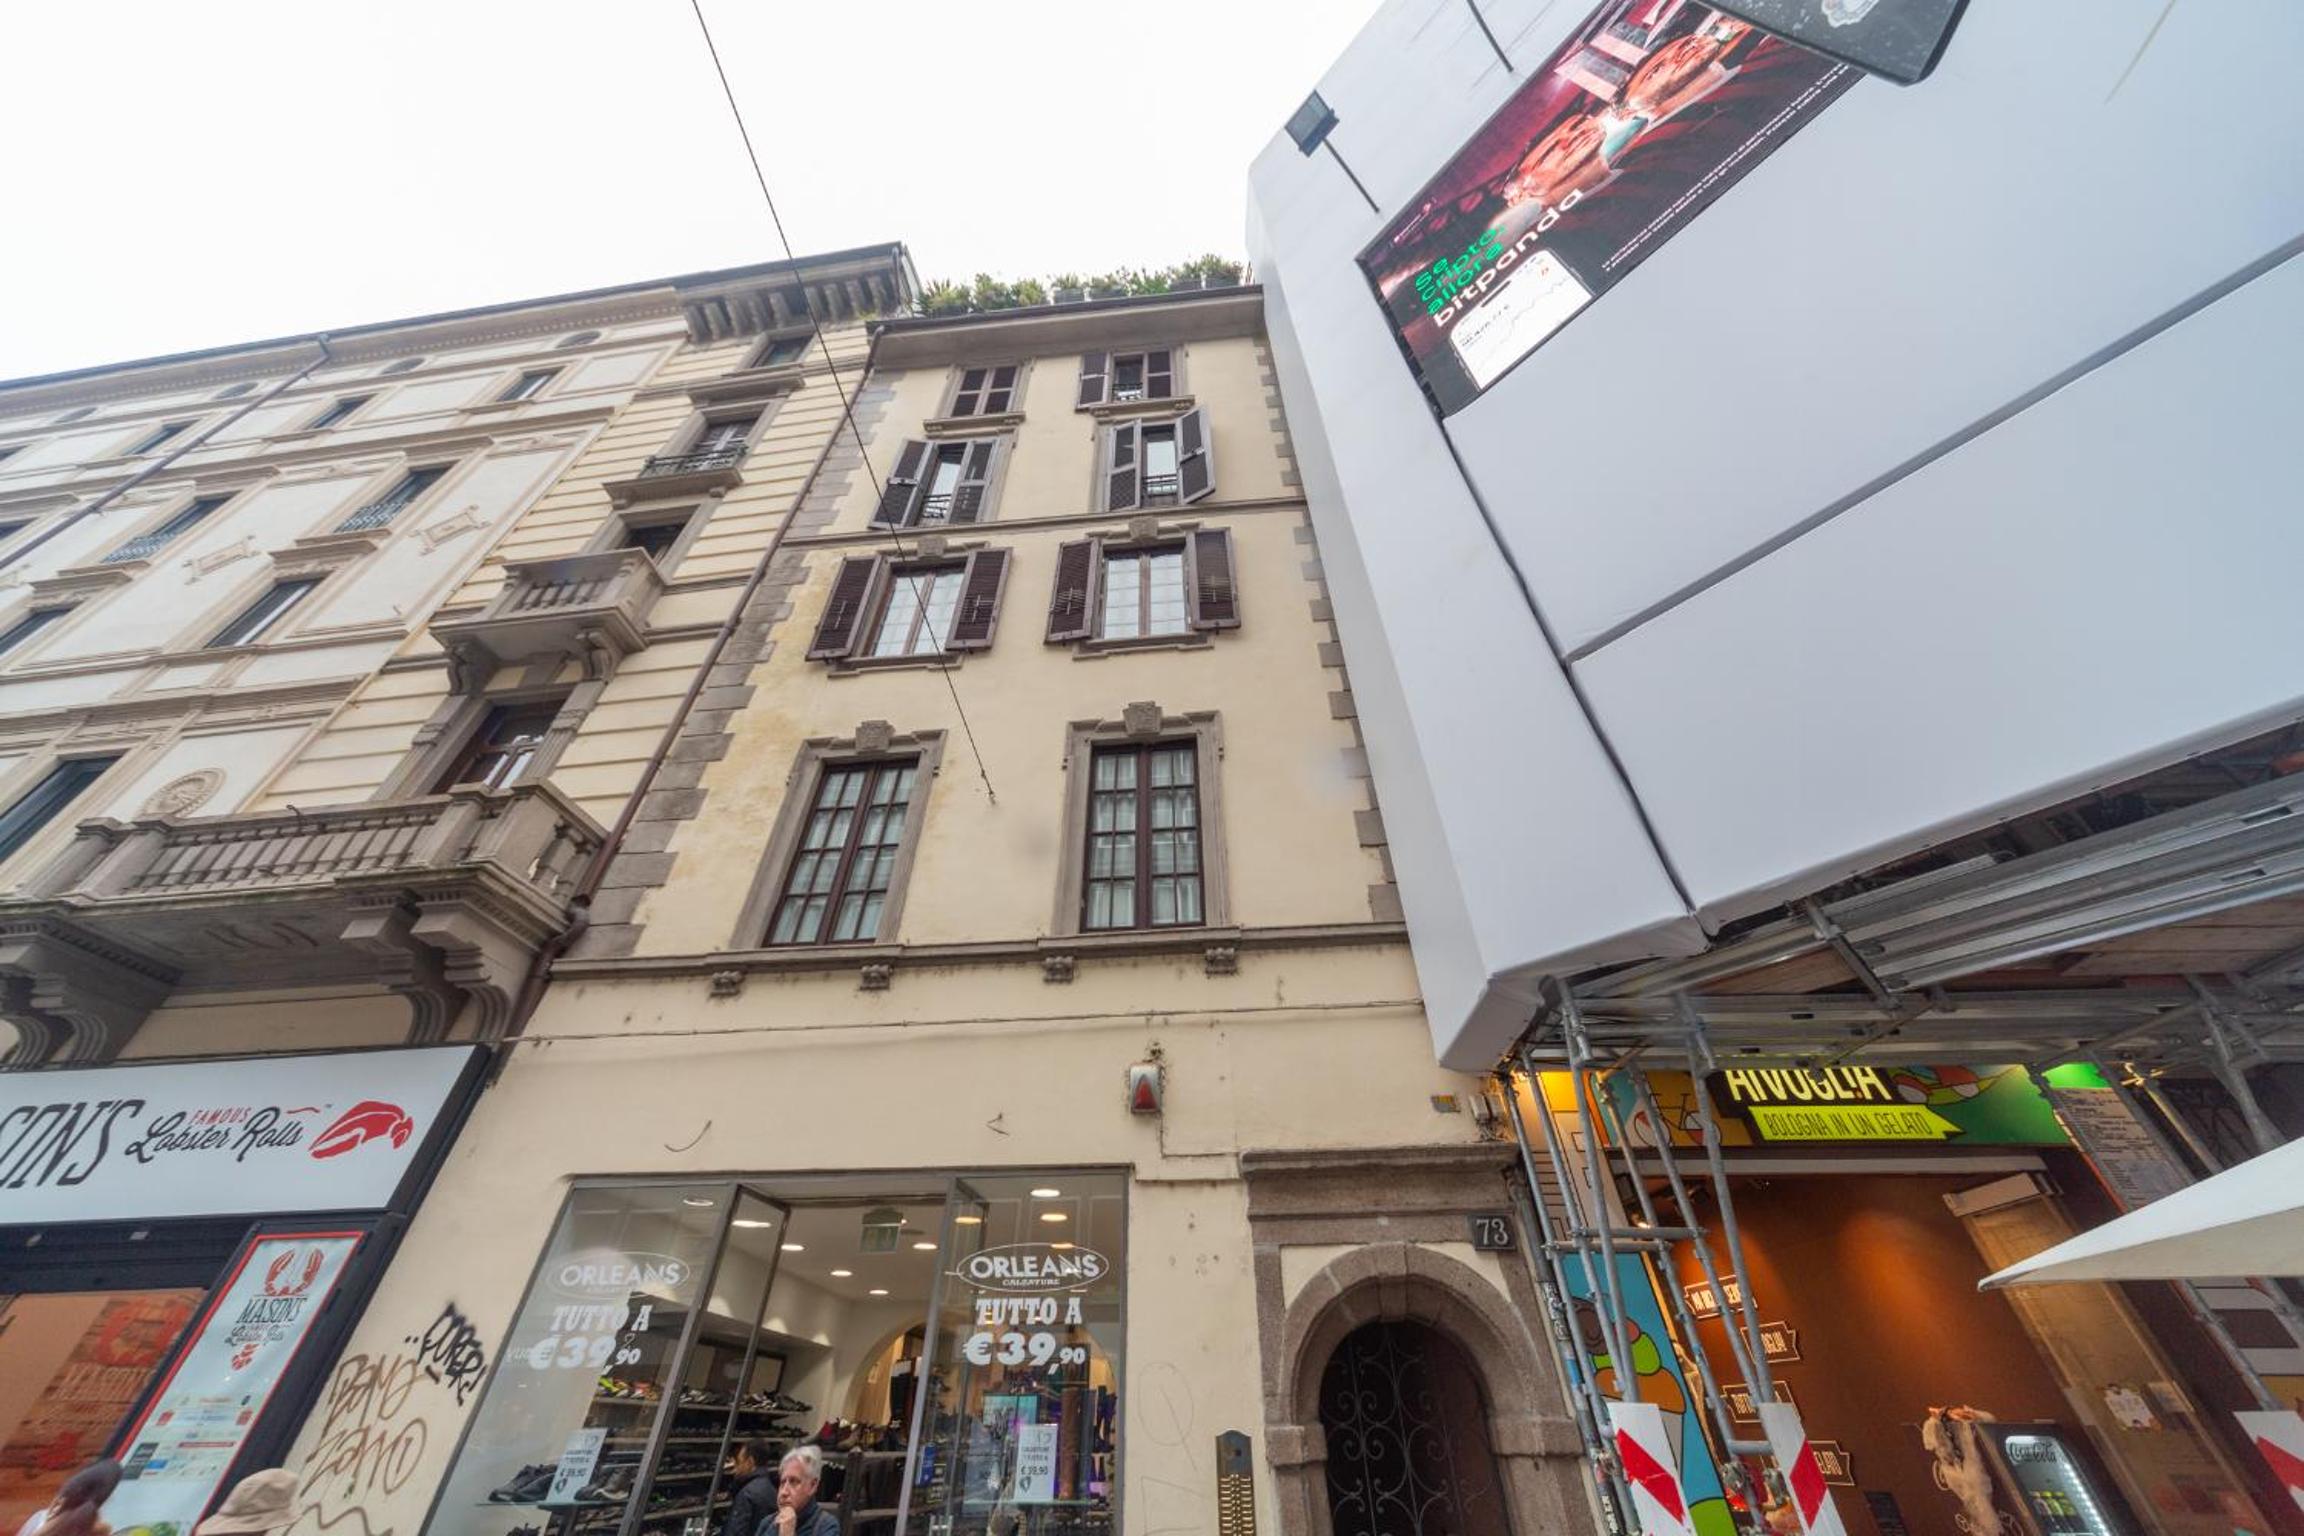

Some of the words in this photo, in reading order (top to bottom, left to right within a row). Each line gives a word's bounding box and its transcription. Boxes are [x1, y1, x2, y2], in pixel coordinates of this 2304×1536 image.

[1433, 188, 1584, 328] bitpanda
[190, 1107, 251, 1125] FAMOUS
[1763, 1112, 1829, 1137] BOLOGNA
[1831, 1113, 1850, 1136] IN
[1849, 1113, 1871, 1136] UN
[1874, 1111, 1934, 1136] GELATO
[125, 1111, 230, 1164] Lobster
[231, 1107, 304, 1162] Rolls
[1476, 1218, 1509, 1246] 73
[560, 1263, 681, 1287] ORLEANS
[970, 1254, 1100, 1278] ORLEANS
[551, 1304, 630, 1332] TUTTO
[631, 1304, 653, 1331] A
[974, 1297, 1057, 1325] TUTTO
[1065, 1297, 1082, 1325] A
